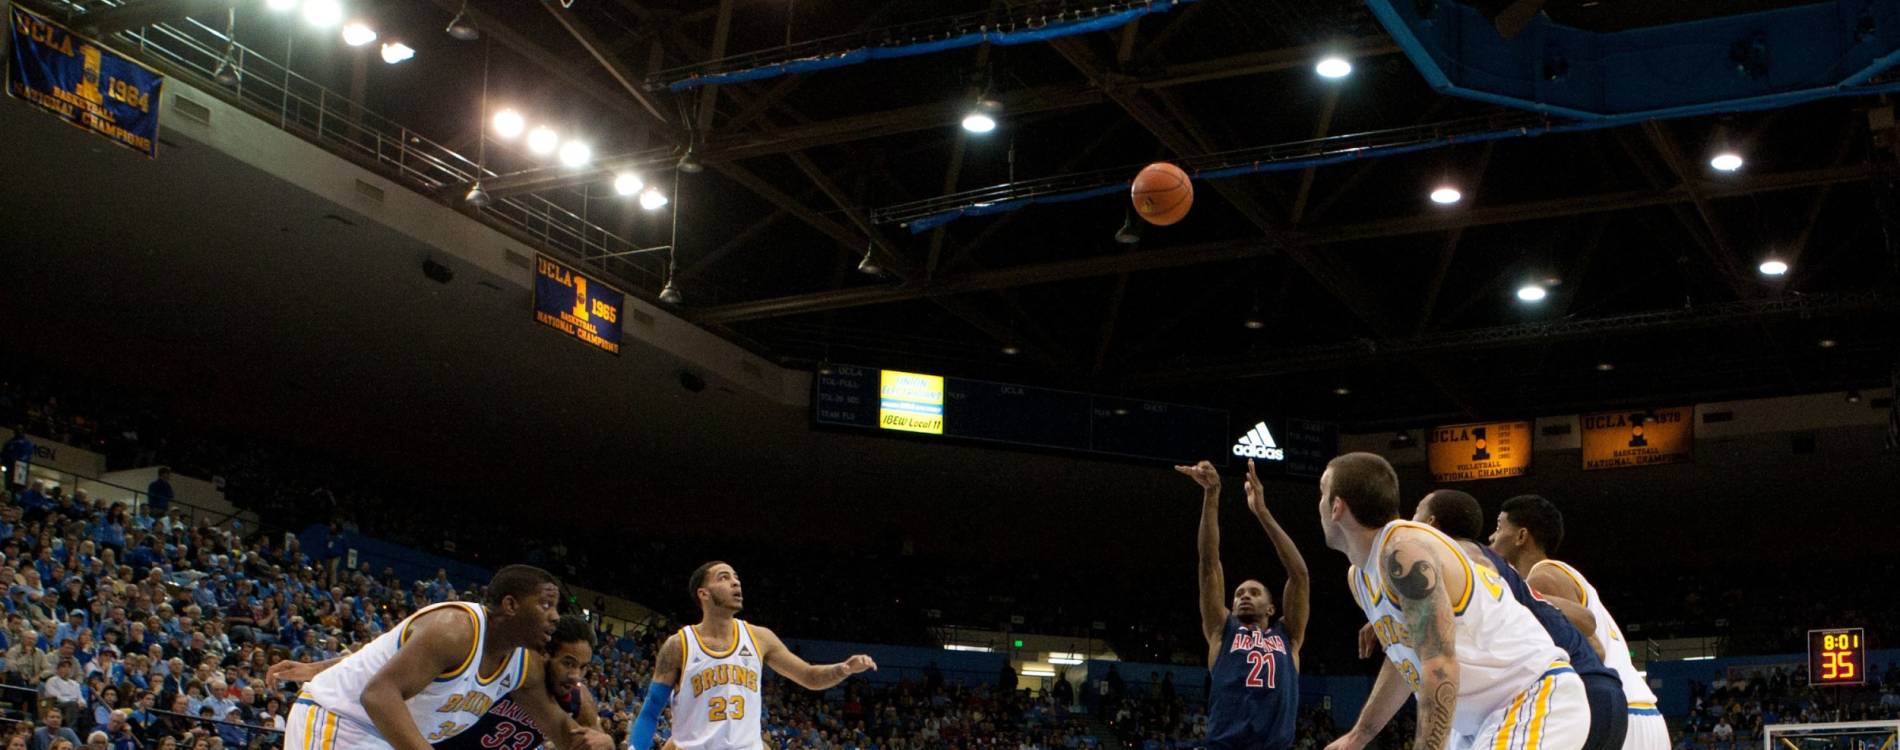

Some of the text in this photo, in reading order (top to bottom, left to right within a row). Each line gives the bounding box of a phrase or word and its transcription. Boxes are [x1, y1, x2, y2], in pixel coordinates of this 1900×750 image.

[15, 12, 75, 58] UCLA
[52, 85, 117, 123] BASKETBALL
[13, 80, 151, 154] NATIONAL CHAMPIONS
[538, 256, 572, 287] UCLA
[536, 310, 620, 355] NATIONAL CHAMPIONS
[560, 311, 598, 335] BASKETBALL
[882, 414, 909, 427] IBEW
[909, 416, 932, 429] Local
[1585, 416, 1626, 431] UCLA
[1430, 429, 1469, 444] UCLA
[1232, 442, 1285, 462] adidas
[1587, 457, 1632, 469] NATIONAL
[1613, 447, 1659, 458] BASKETBALL
[1433, 469, 1475, 480] NATIONAL
[1457, 461, 1501, 471] VOLLEYBALL
[1230, 630, 1287, 655] ARZNA
[1824, 633, 1859, 651] 8:01
[1245, 650, 1276, 689] 21
[1822, 651, 1854, 679] 35
[691, 663, 758, 699] BRUINS
[708, 695, 745, 722] 23
